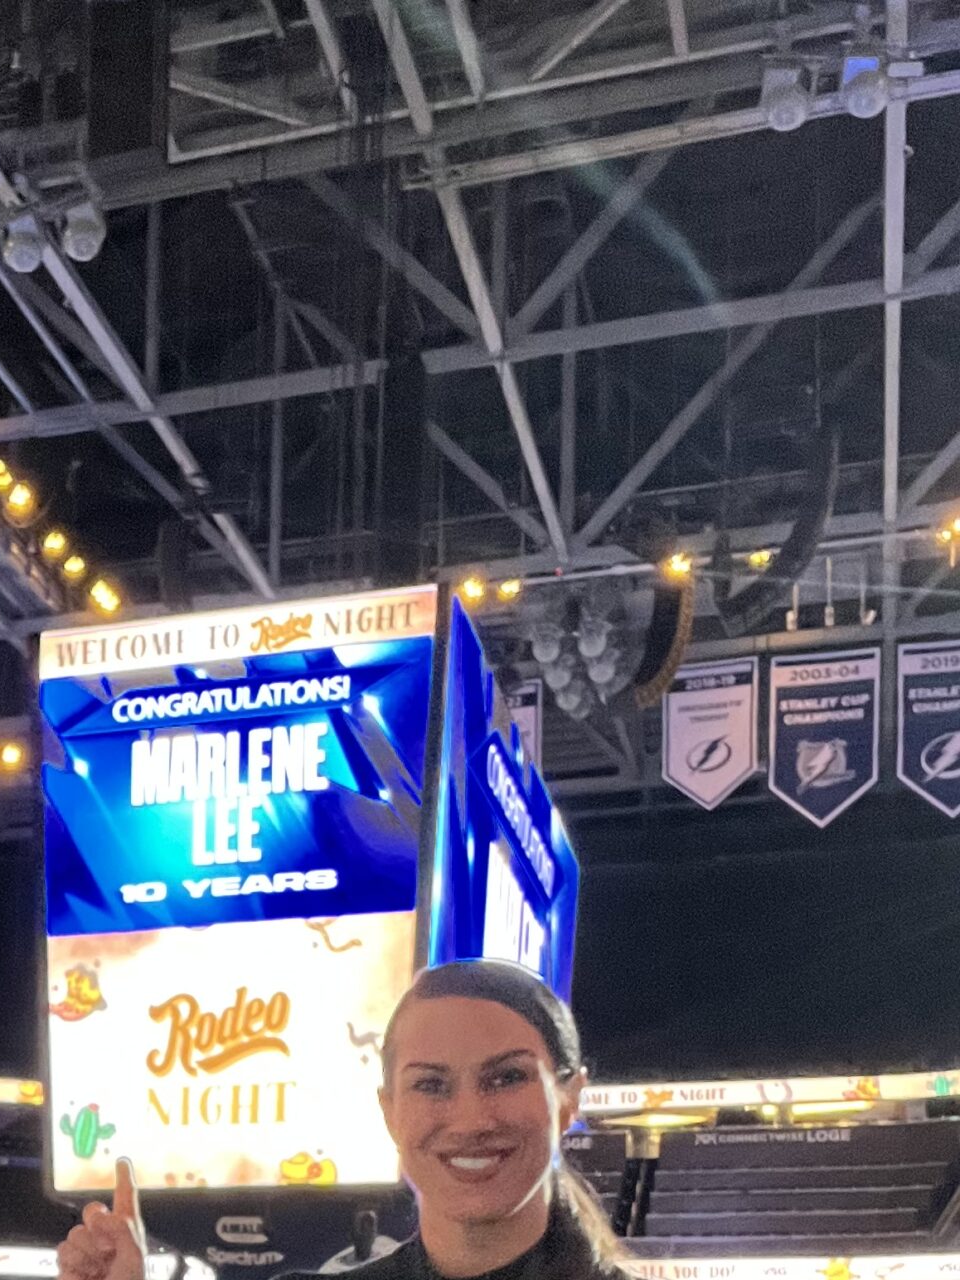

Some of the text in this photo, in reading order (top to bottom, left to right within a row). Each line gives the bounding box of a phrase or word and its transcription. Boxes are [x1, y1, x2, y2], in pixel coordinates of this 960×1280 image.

[56, 601, 420, 668] WELCOME TO Rodeo NIGHT
[111, 674, 351, 723] CONGRATULATIONS!
[130, 722, 330, 807] MARLENE
[191, 800, 263, 866] LEE
[120, 868, 338, 904] 10 YEARS
[145, 986, 291, 1078] Rodeo
[145, 1081, 296, 1126] NIGHT
[620, 1091, 638, 1105] TO
[679, 1087, 727, 1101] NIGHT
[806, 1129, 851, 1143] LOGE
[206, 1246, 285, 1267] Spectrum
[673, 1264, 699, 1279] YOU
[709, 1264, 735, 1279] DO!
